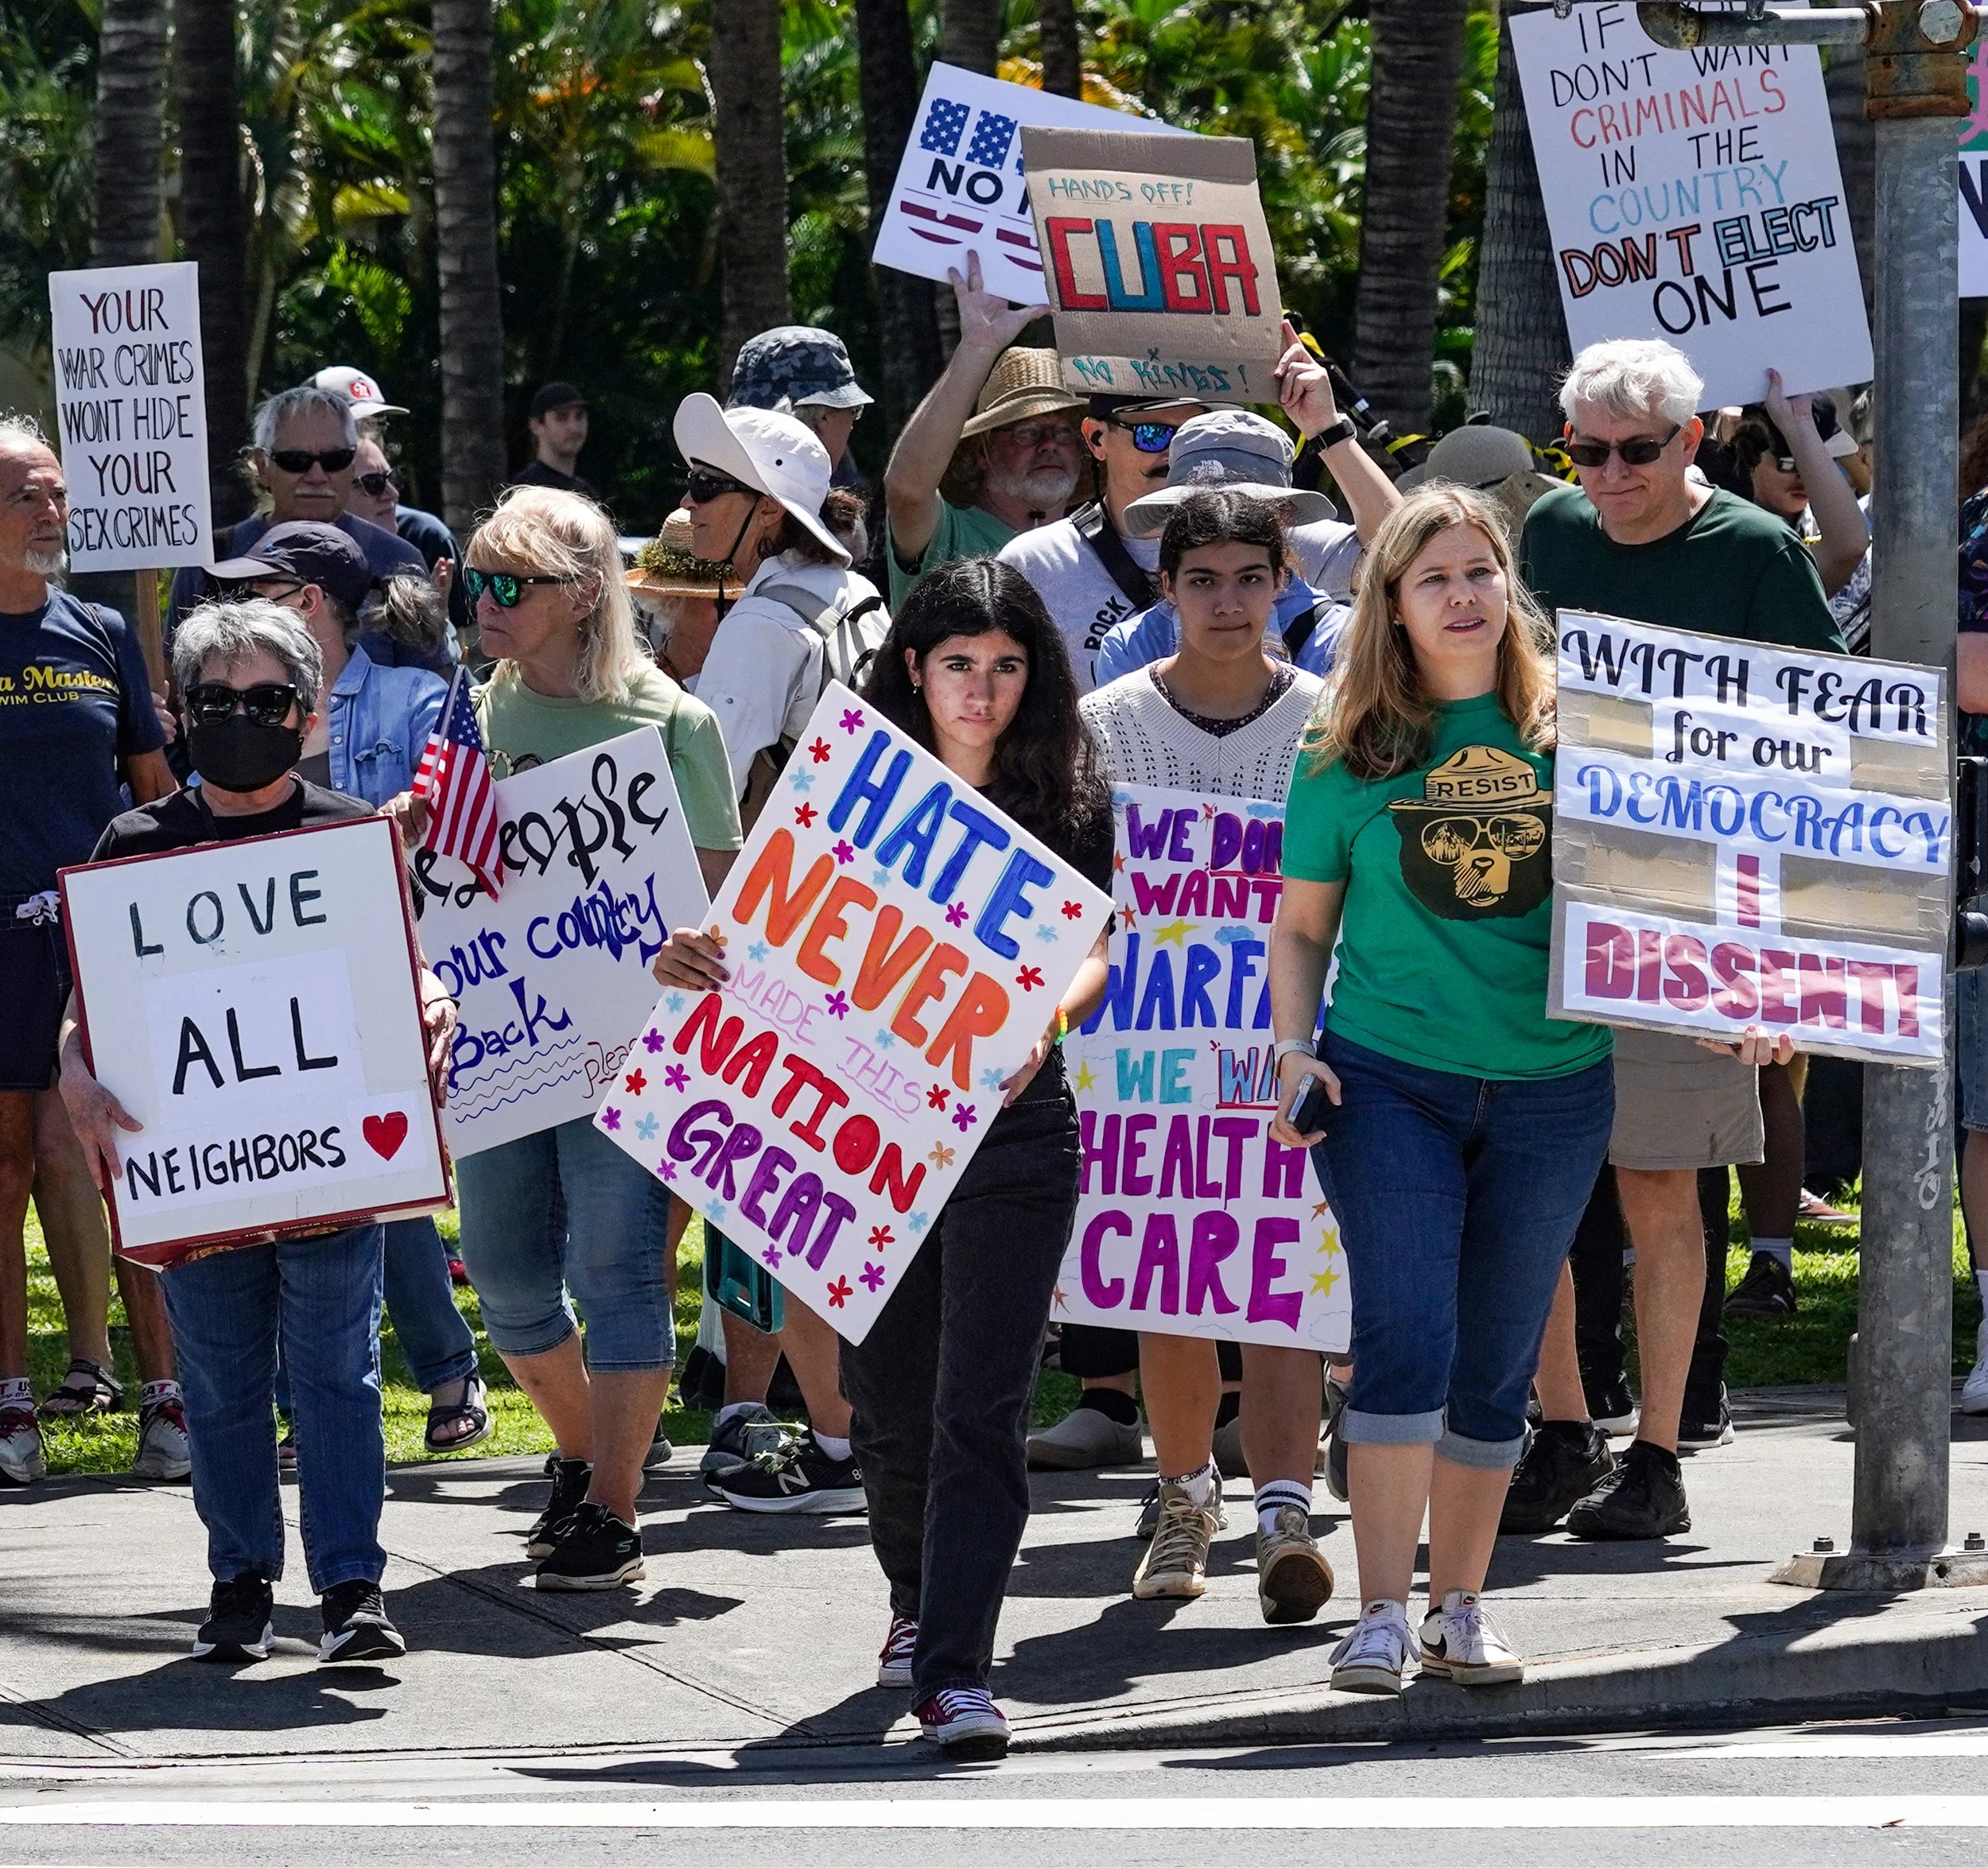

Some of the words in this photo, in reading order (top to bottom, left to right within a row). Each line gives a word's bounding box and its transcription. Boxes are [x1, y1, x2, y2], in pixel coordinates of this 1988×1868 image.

[1578, 3, 1625, 54] IF
[1551, 52, 1657, 107] DON'T
[1570, 68, 1786, 149] CRIMINALS
[926, 157, 1004, 205] NO
[1048, 177, 1132, 201] HANDS
[1140, 182, 1194, 205] OFF!
[1600, 146, 1637, 188] IN
[1687, 125, 1764, 169] THE
[1589, 160, 1788, 235] COUNTRY
[1046, 216, 1260, 317] CUBA
[1560, 223, 1700, 299] DON'T
[1713, 196, 1839, 269] ELECT
[80, 289, 169, 334] YOUR
[1652, 260, 1792, 334] ONE
[58, 348, 109, 390] WAR
[115, 340, 194, 386] CRIMES
[1073, 355, 1113, 386] NO
[134, 394, 193, 441] HIDE
[87, 450, 177, 497] YOUR
[68, 507, 113, 552] SEX
[113, 504, 198, 549] CRIMES
[1084, 594, 1128, 651] ROCK
[33, 691, 80, 704] CLUB
[1561, 630, 1749, 709] WITH
[1776, 666, 1928, 736] FEAR
[1665, 710, 1739, 764] for
[1752, 736, 1832, 775] our
[1437, 773, 1533, 798] RESIST
[1576, 764, 1948, 864] DEMOCRACY
[827, 729, 1055, 961] HATE
[1126, 805, 1198, 864] WE
[1210, 812, 1283, 876] DON
[130, 869, 327, 957] LOVE
[1131, 868, 1283, 924] WANT
[1737, 854, 1760, 929] I
[732, 828, 1011, 1093] NEVER
[1080, 932, 1272, 1036] WARF
[1585, 921, 1920, 1038] DISSENT!
[173, 997, 338, 1095] ALL
[731, 962, 824, 1047] MADE
[845, 1035, 922, 1114] THIS
[1116, 1047, 1197, 1105] WE
[1218, 1044, 1282, 1104] WA
[672, 992, 926, 1214] NATION
[126, 1126, 346, 1200] NEIGHBORS
[666, 1099, 856, 1271] GREAT
[1080, 1110, 1307, 1209] HEALTH
[1081, 1210, 1303, 1331] CARE
